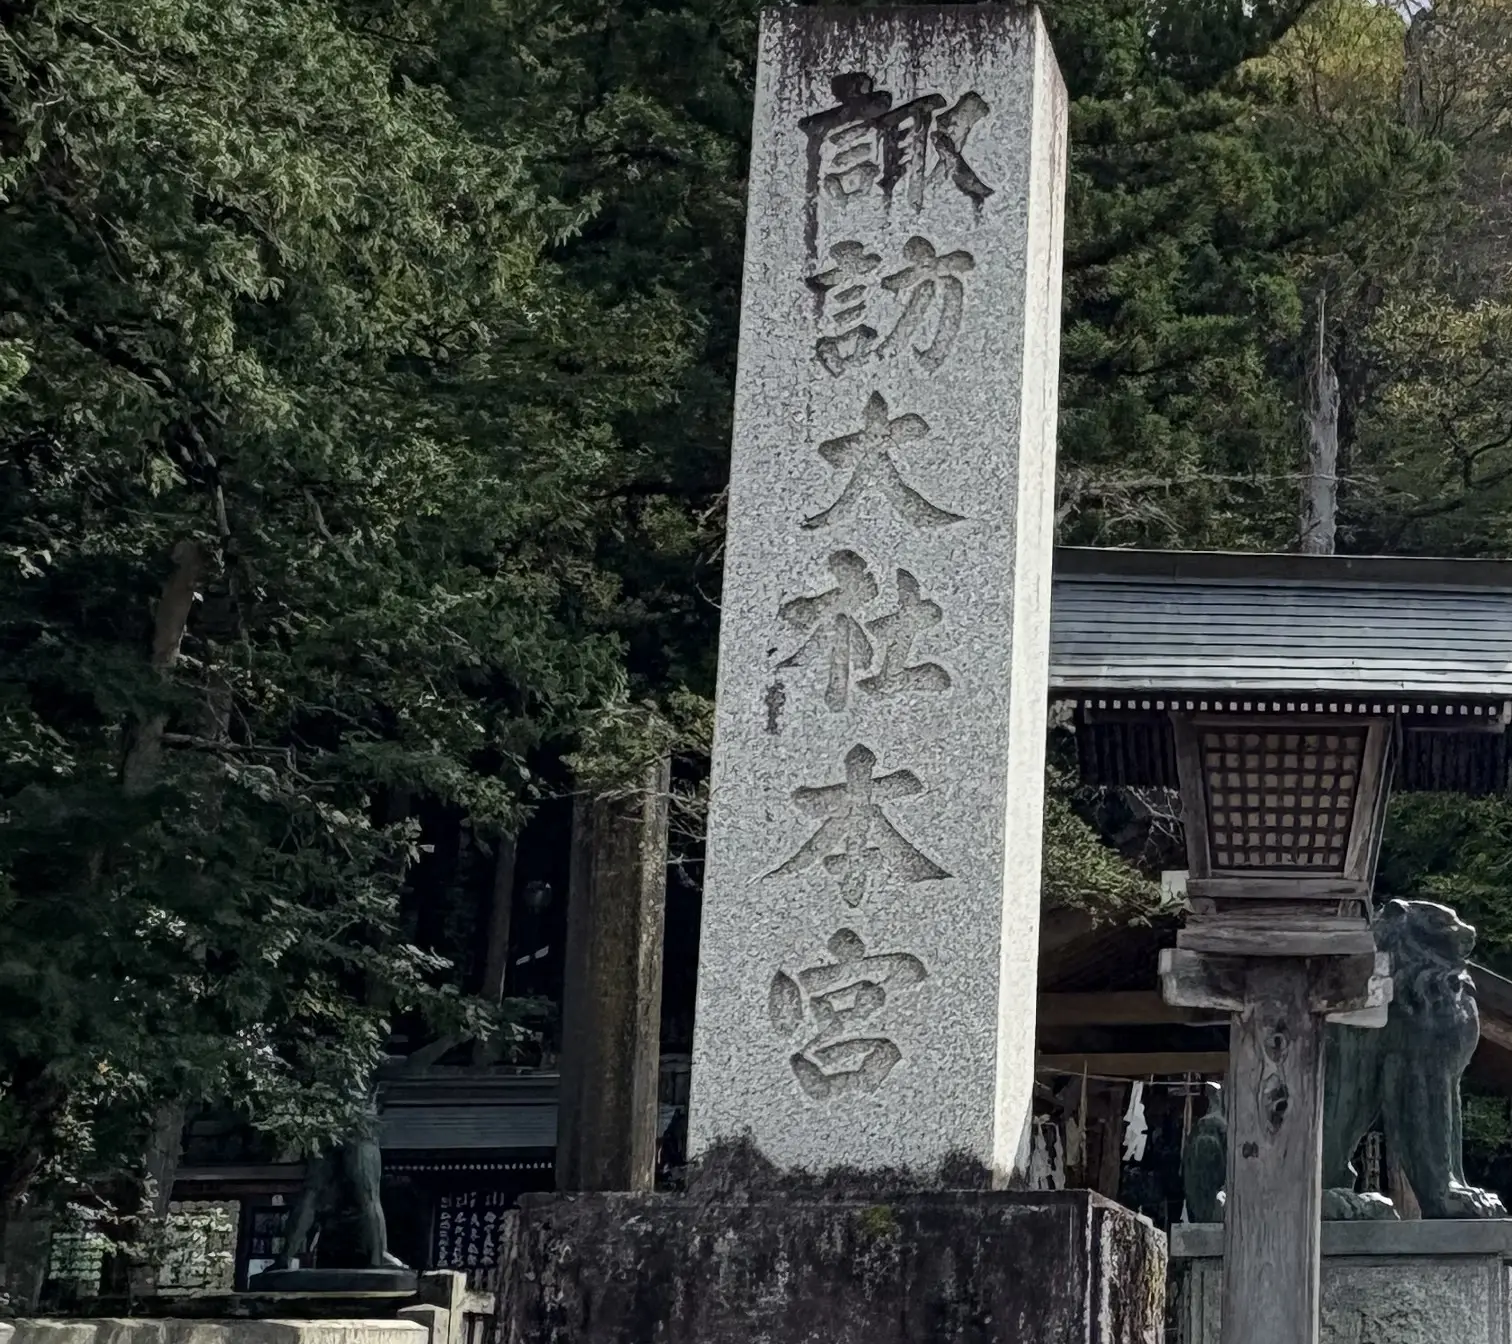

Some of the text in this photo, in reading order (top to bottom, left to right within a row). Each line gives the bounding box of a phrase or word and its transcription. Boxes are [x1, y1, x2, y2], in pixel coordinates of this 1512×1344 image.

[748, 71, 992, 1102] 諏訪大社本宮
